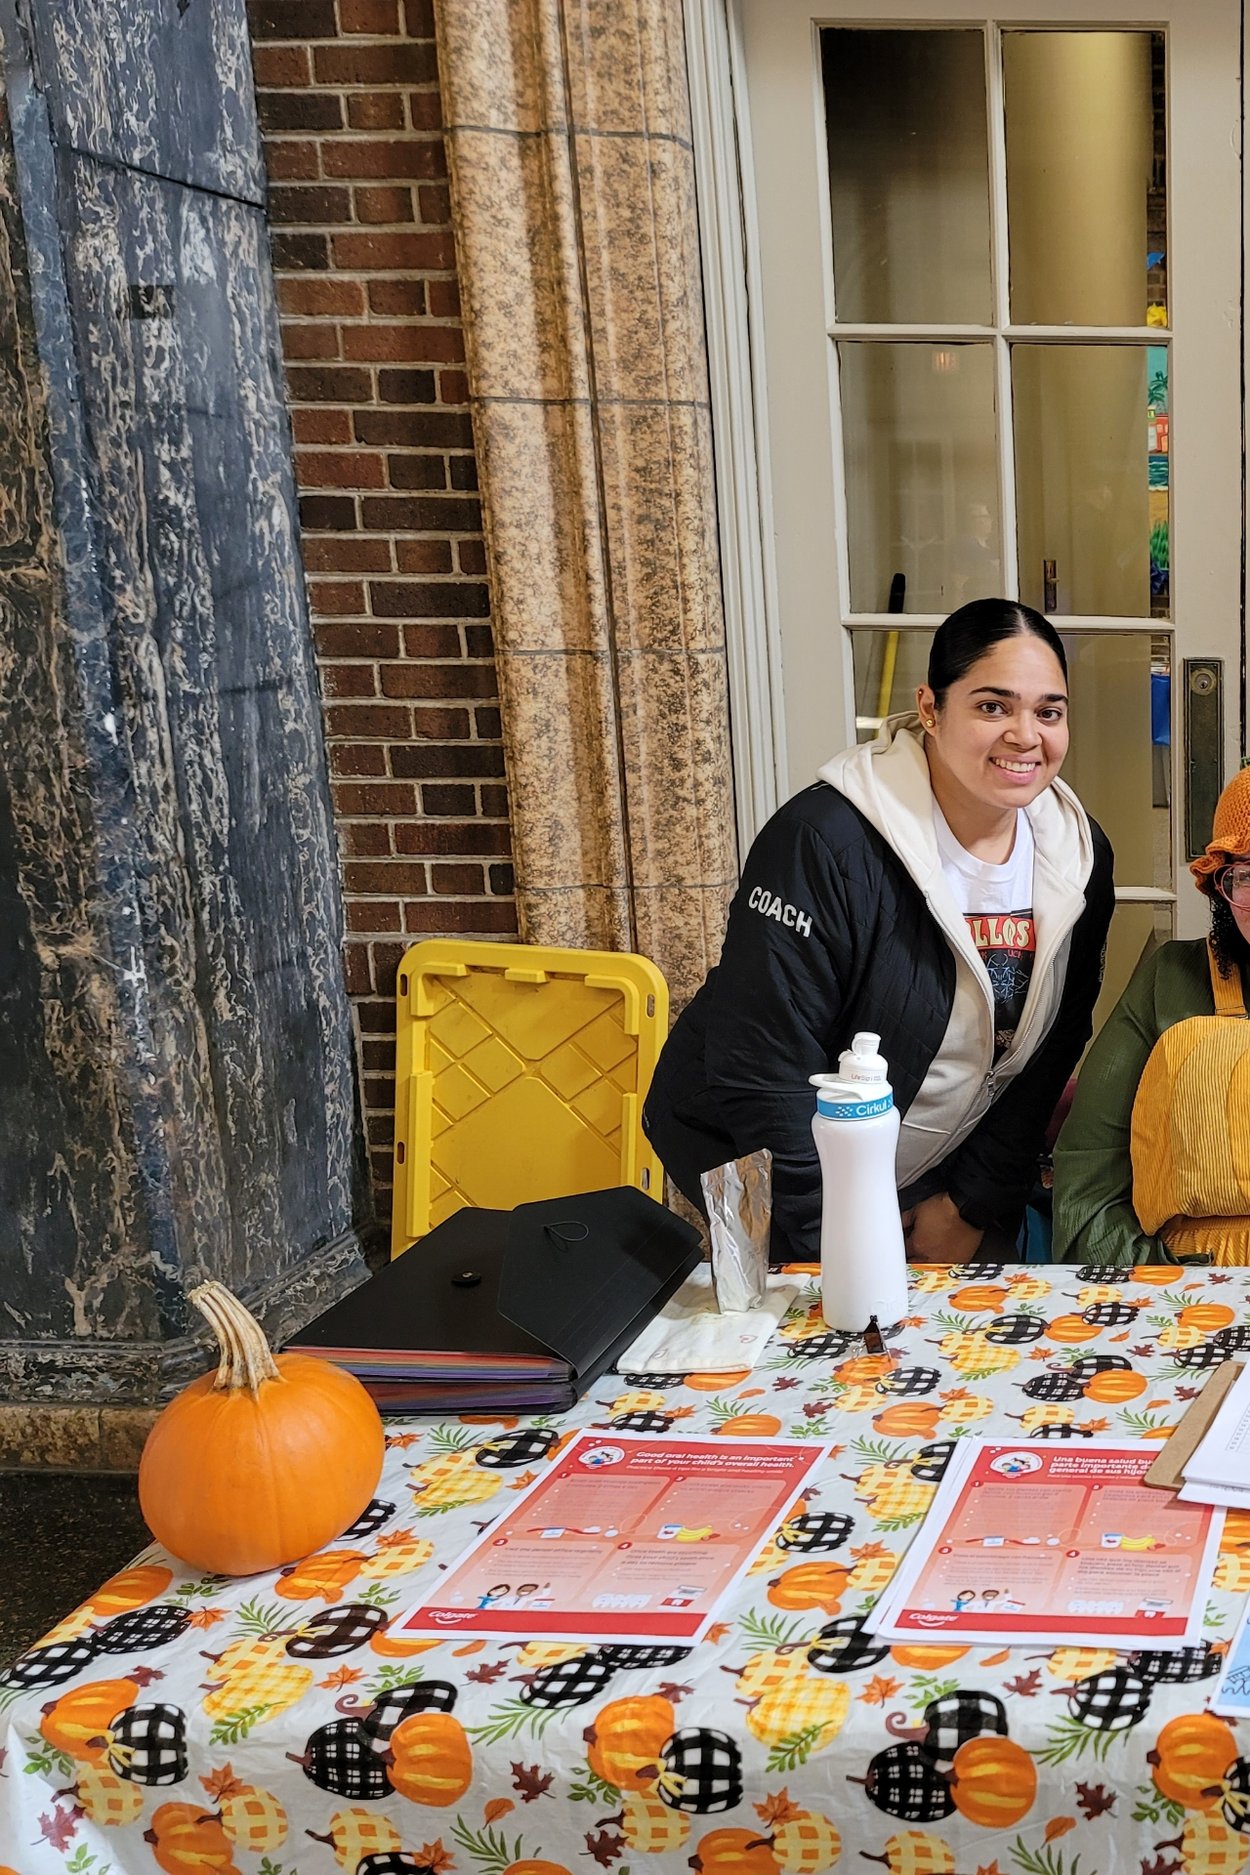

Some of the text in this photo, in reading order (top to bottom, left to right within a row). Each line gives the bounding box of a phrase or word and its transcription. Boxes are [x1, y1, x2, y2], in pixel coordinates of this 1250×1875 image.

[748, 886, 813, 938] COACH
[855, 1099, 887, 1116] Cirkul
[635, 1451, 665, 1459] Good
[743, 1454, 794, 1463] important
[1075, 1456, 1107, 1464] buena
[630, 1457, 653, 1465] part
[667, 1459, 690, 1467] your
[691, 1459, 723, 1467] child's
[724, 1460, 759, 1468] overall
[759, 1461, 795, 1469] health.
[1080, 1462, 1135, 1470] importante
[428, 1610, 479, 1619] Colgate
[909, 1612, 959, 1622] Colgate
